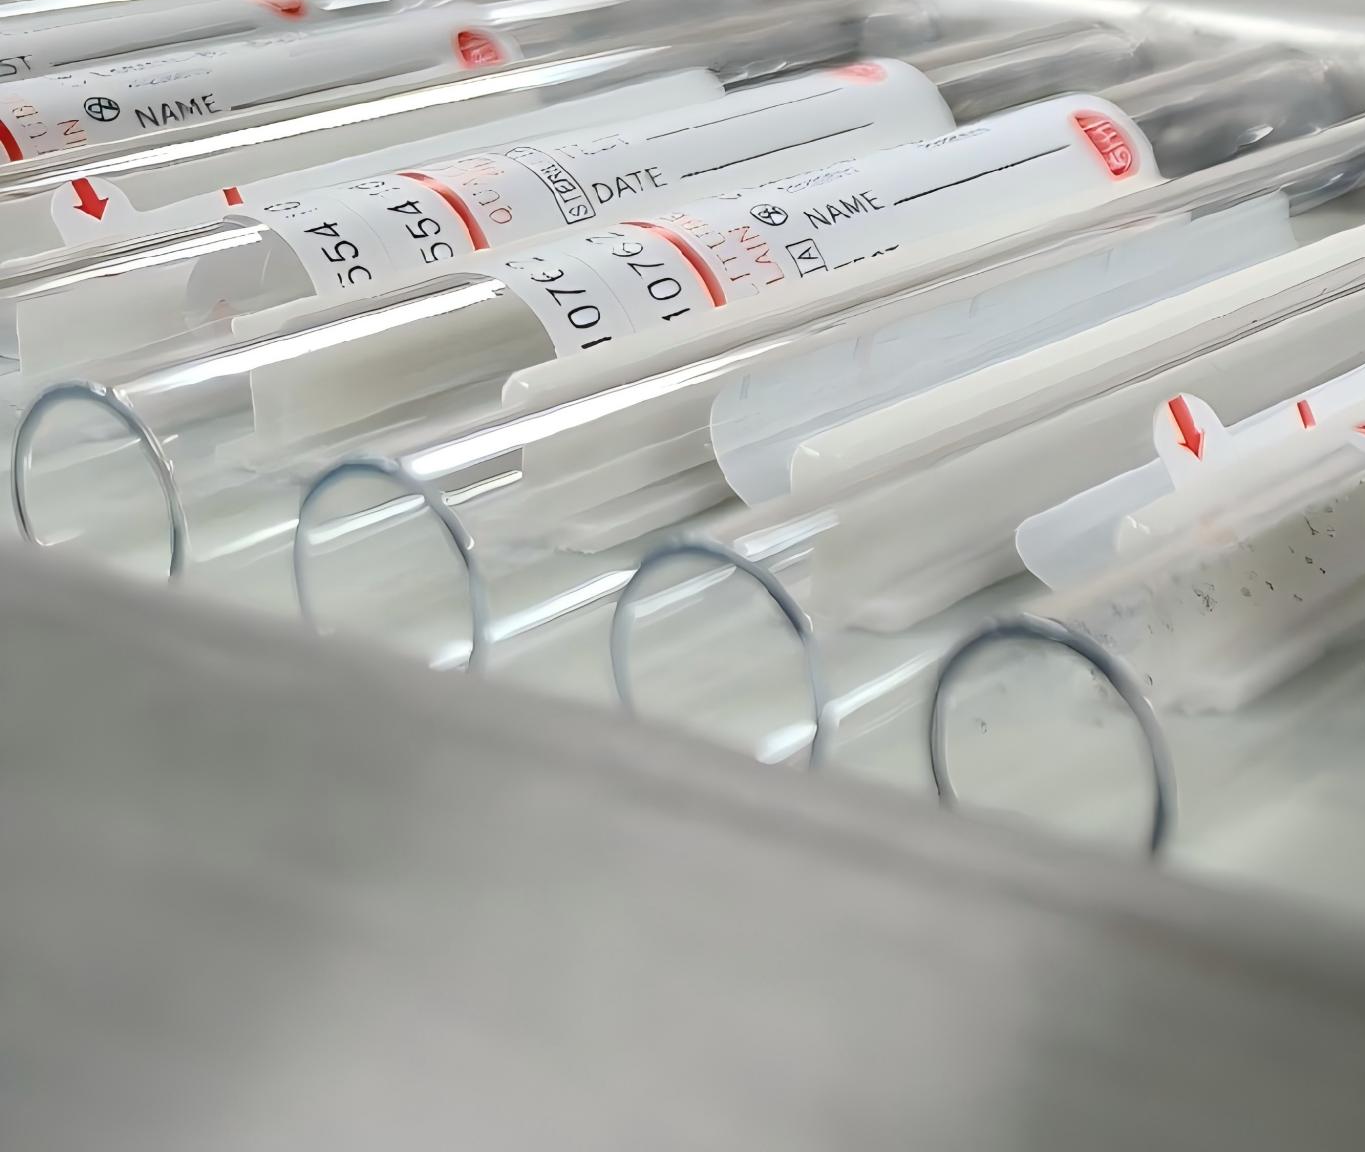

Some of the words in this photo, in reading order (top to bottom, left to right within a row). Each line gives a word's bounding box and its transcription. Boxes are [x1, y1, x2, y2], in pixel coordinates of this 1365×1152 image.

[135, 94, 222, 128] NAME
[591, 166, 668, 205] DATE
[803, 189, 885, 230] NAME
